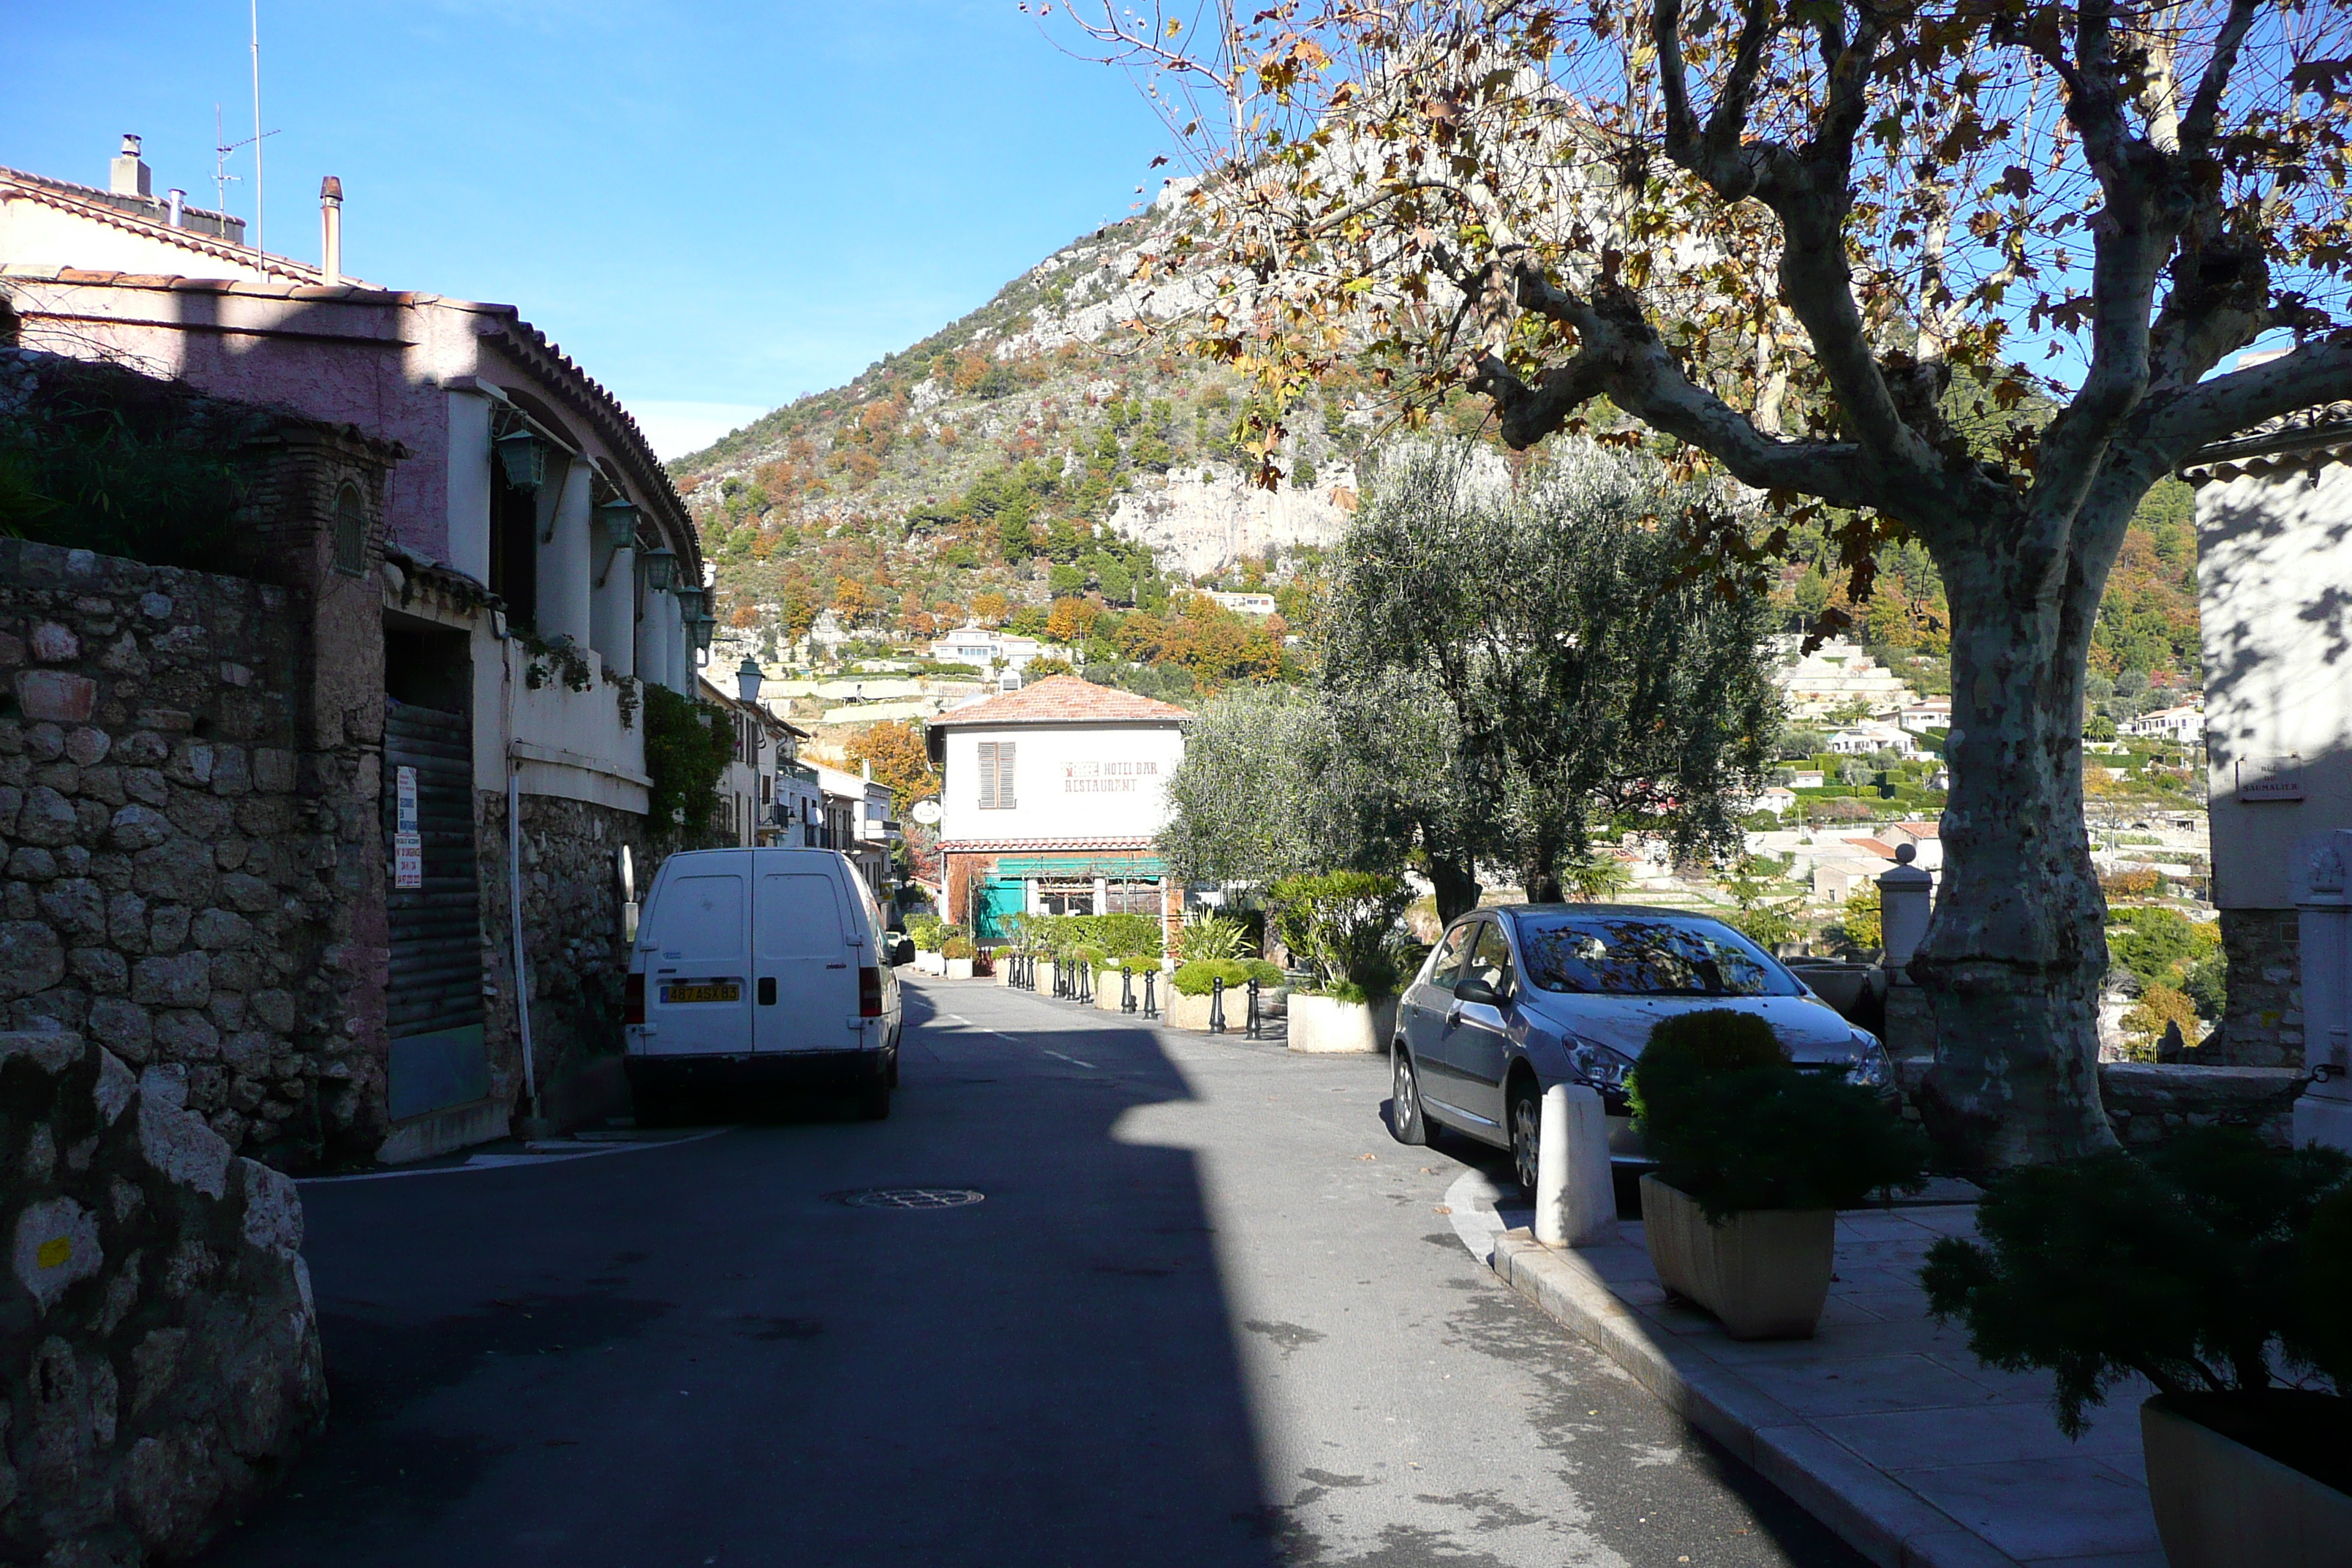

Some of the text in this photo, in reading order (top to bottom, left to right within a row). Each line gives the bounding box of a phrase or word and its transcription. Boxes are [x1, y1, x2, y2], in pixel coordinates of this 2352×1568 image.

[1104, 762, 1133, 775] HOTEL
[1137, 762, 1158, 774] BAR
[1065, 779, 1137, 792] RESTAURANT
[2243, 783, 2298, 792] SAUMALIER
[671, 986, 736, 1000] 487 ASX 83
